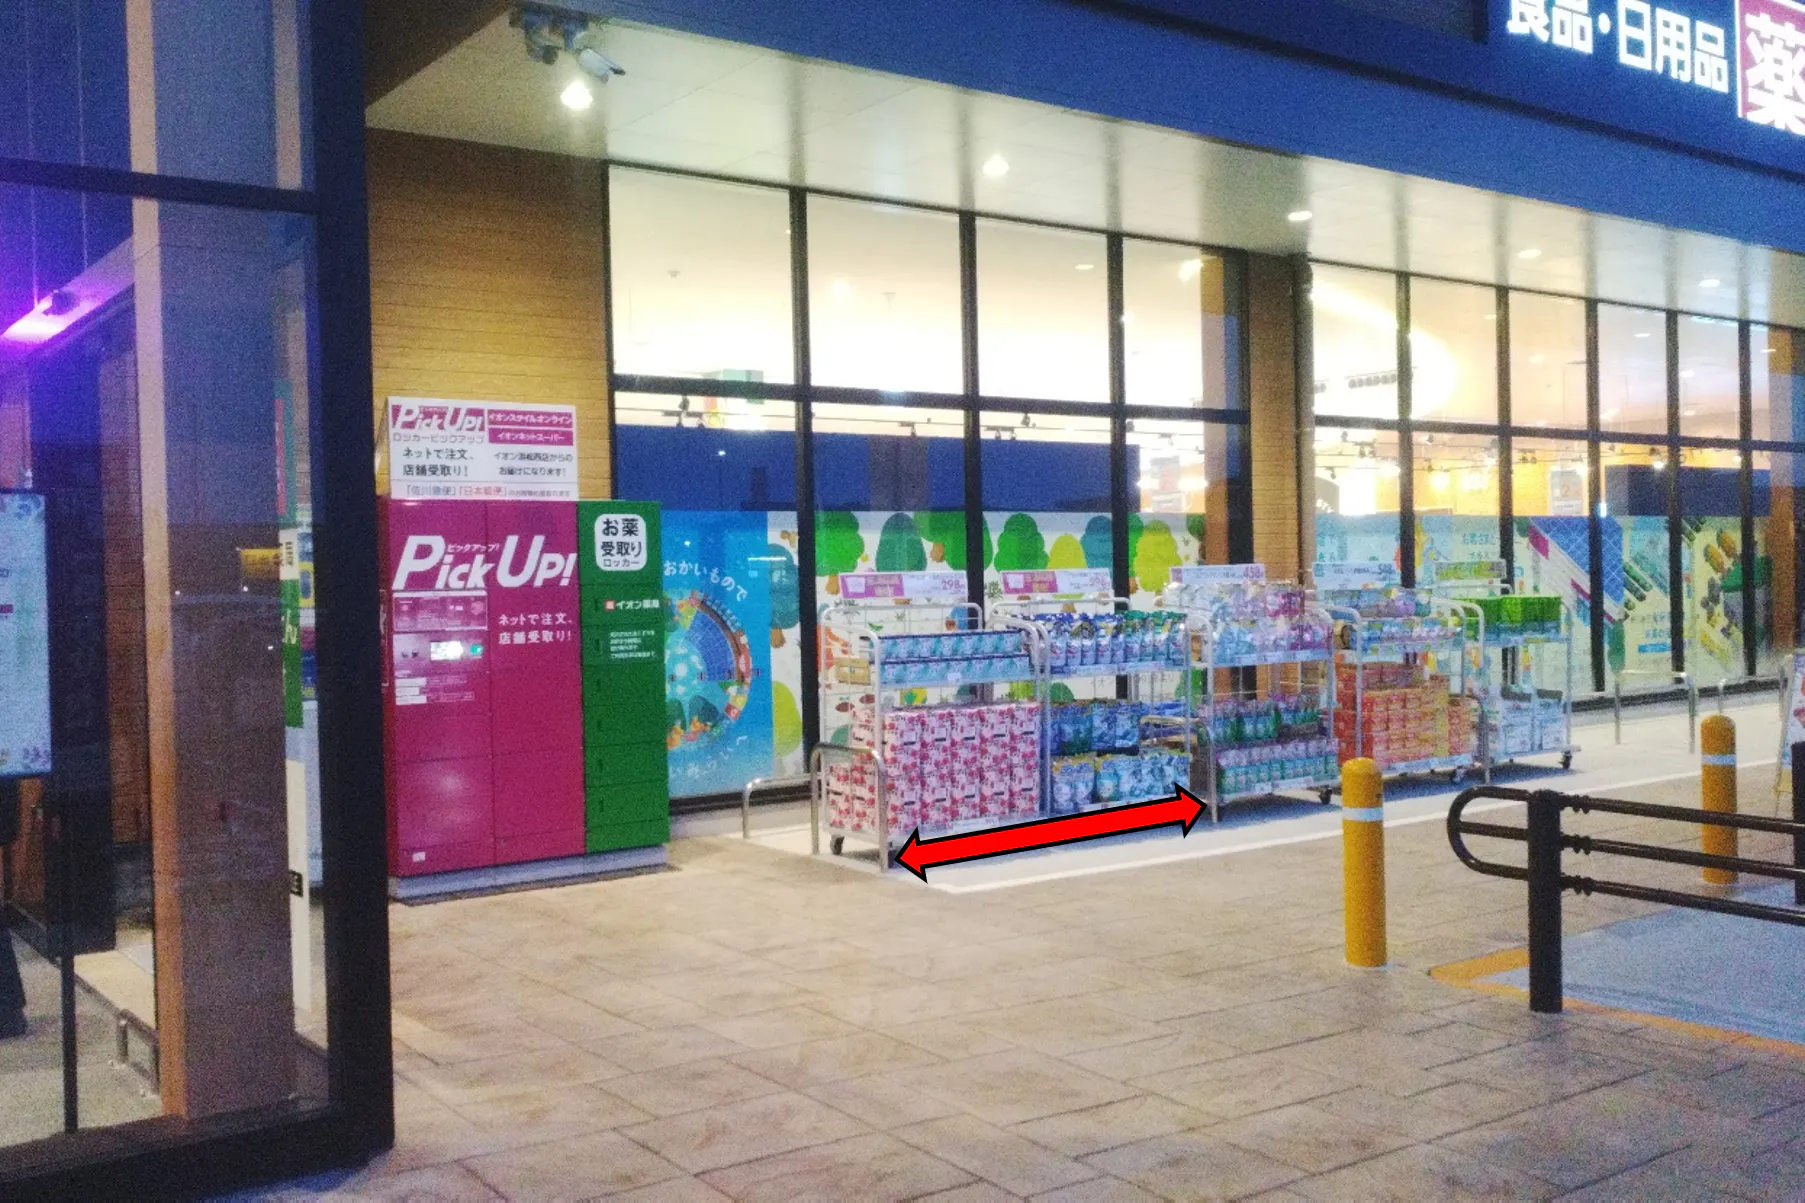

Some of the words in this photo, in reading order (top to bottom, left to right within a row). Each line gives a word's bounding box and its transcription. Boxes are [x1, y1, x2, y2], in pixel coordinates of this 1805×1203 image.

[1745, 12, 1805, 136] 薬
[602, 518, 639, 537] お薬
[392, 535, 495, 591] Pick
[601, 541, 642, 557] 受取り
[603, 559, 640, 568] ロッカー
[663, 559, 748, 602] おかいもので
